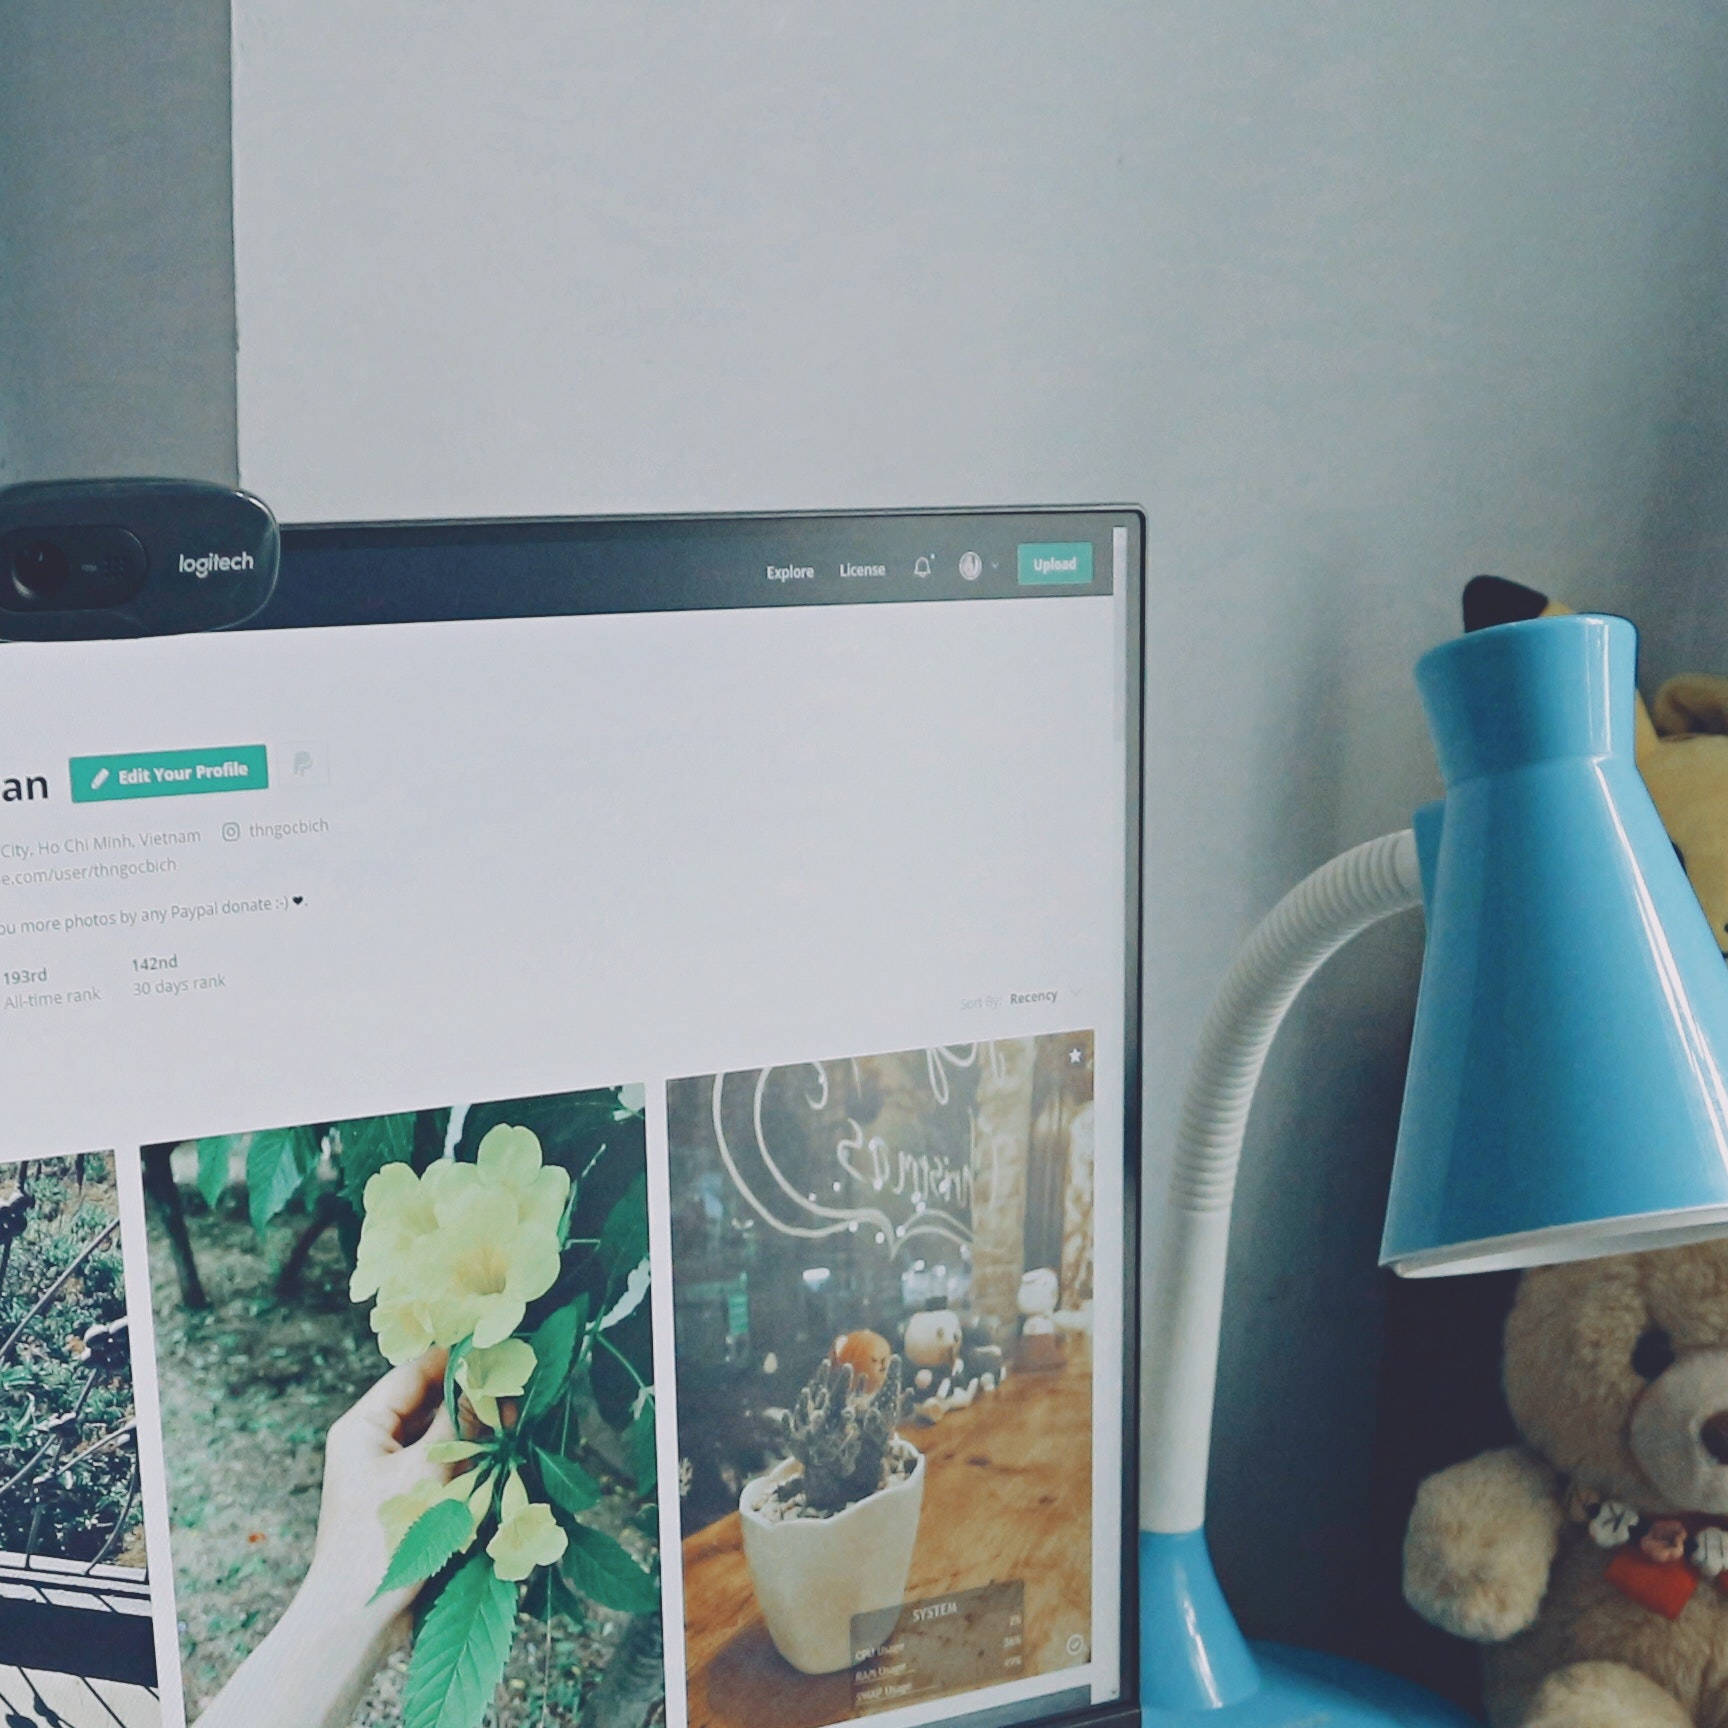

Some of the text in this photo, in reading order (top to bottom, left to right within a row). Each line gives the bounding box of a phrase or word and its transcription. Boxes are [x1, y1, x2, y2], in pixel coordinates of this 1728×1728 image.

[179, 551, 254, 578] logitech
[767, 564, 814, 581] Explore
[840, 561, 885, 577] License
[1034, 556, 1076, 573] Upload
[119, 761, 248, 785] Edit Your Profile
[249, 818, 329, 843] thngocbich
[39, 841, 60, 855] Ho
[138, 830, 201, 847] Vietnam
[20, 918, 60, 933] more
[65, 911, 116, 933] photos
[120, 910, 137, 926] by
[141, 910, 167, 924] any
[171, 901, 219, 921] Paypal
[222, 897, 272, 913] donate
[132, 955, 178, 971] 142nd
[4, 969, 47, 985] 193rd
[133, 974, 225, 996] 30 days rank
[4, 986, 101, 1009] All-time rank
[1010, 990, 1057, 1004] Recency
